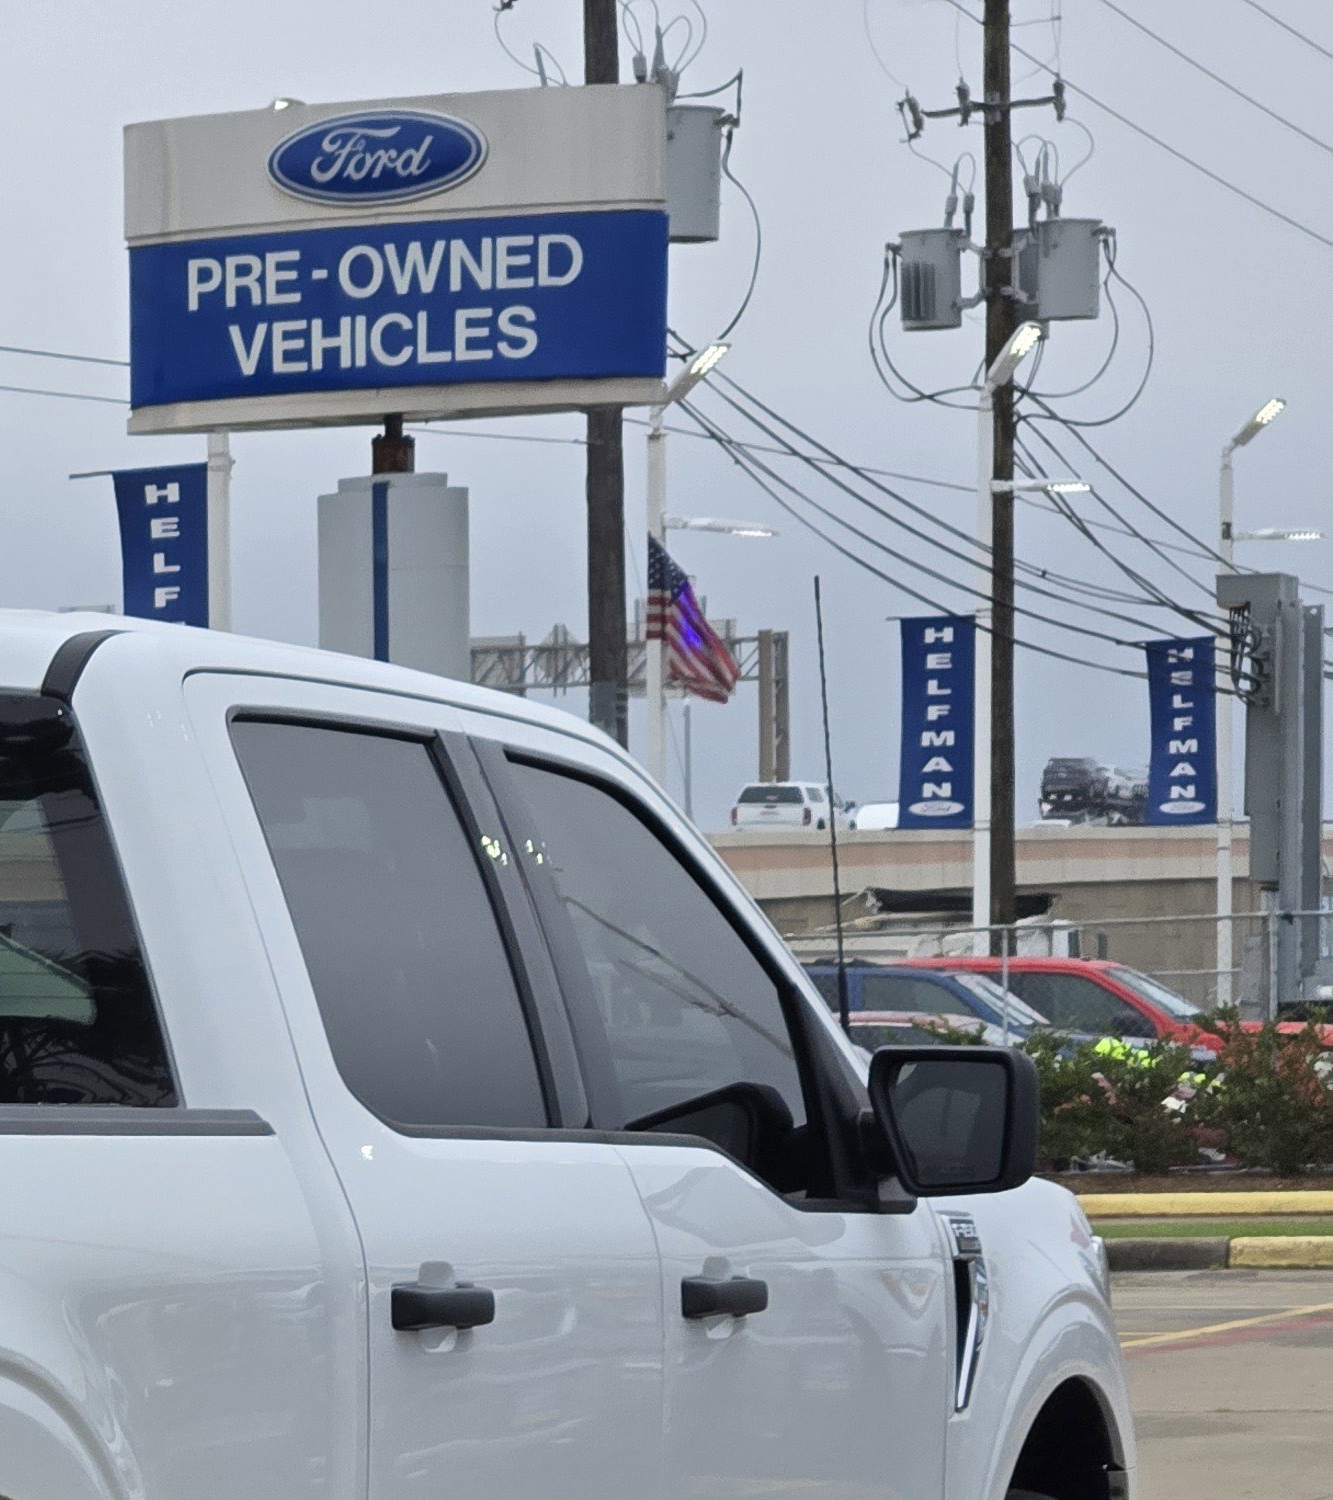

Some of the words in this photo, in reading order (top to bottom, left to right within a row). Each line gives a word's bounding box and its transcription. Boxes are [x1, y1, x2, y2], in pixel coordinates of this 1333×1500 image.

[310, 124, 432, 183] Ford
[230, 306, 538, 376] VEHICLES
[144, 482, 181, 609] HELF
[921, 627, 955, 798] HELFMAN
